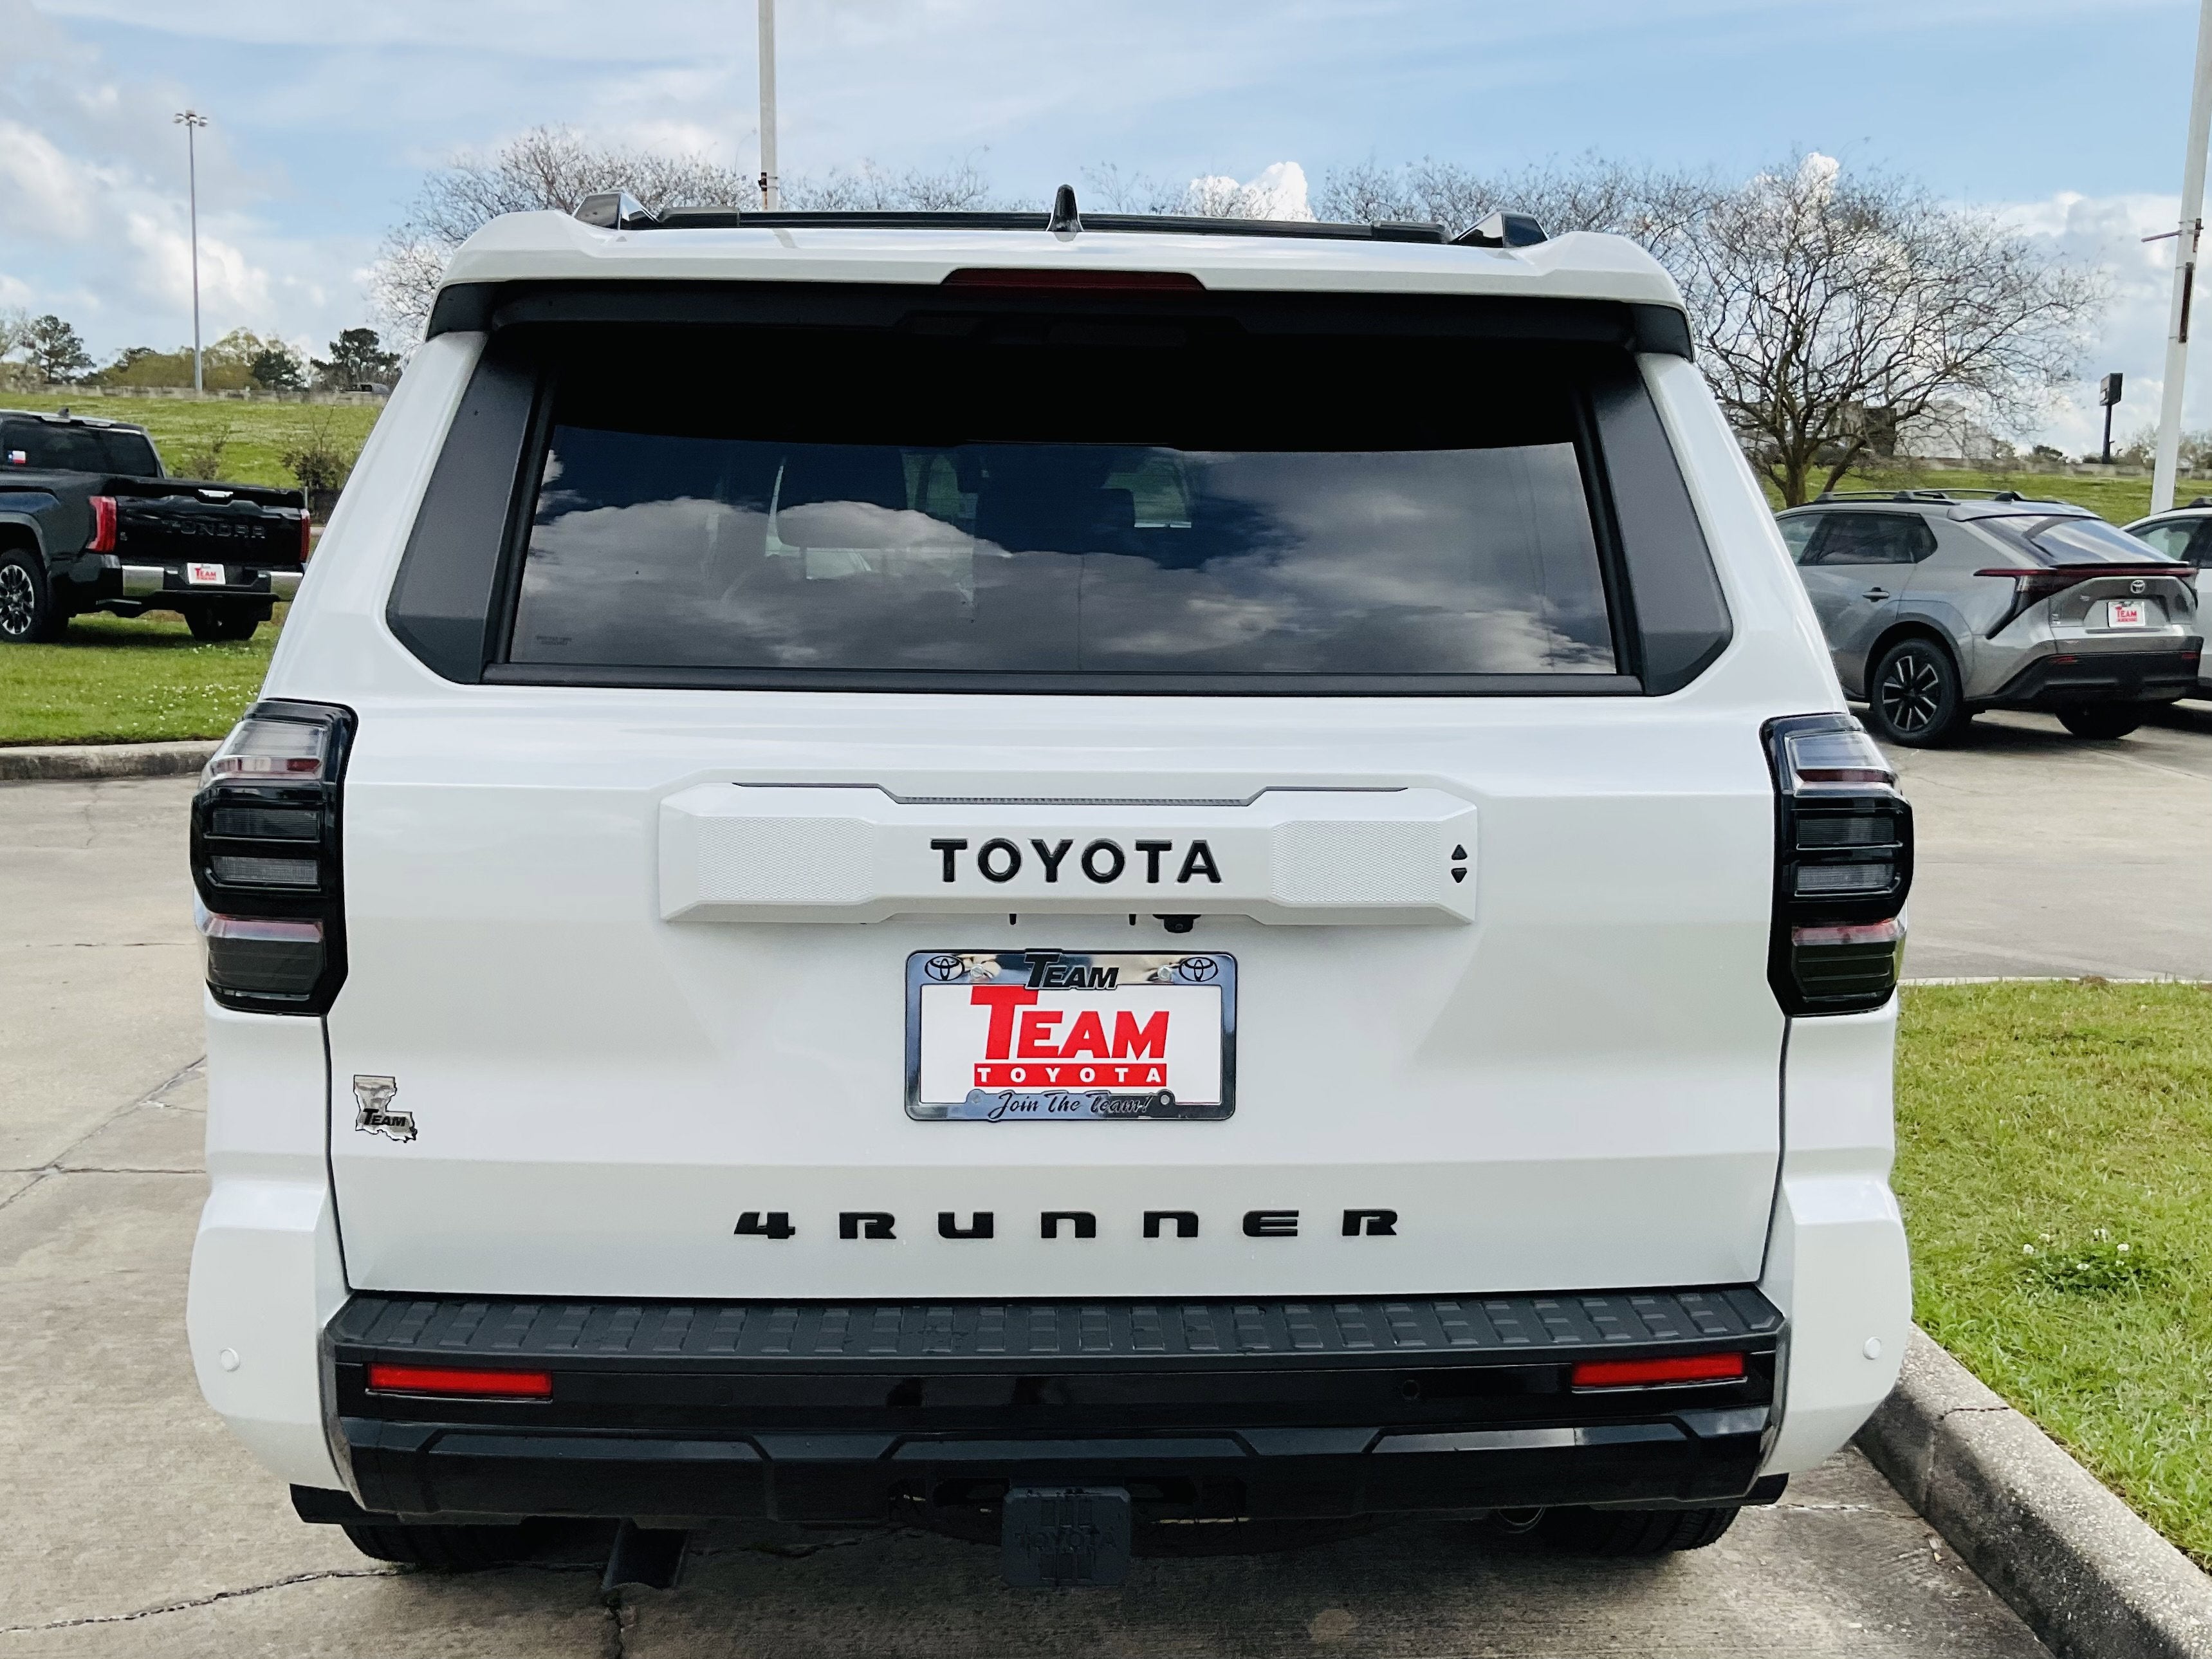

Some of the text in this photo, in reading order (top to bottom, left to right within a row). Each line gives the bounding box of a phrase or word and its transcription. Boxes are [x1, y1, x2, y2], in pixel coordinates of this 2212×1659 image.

[161, 520, 266, 539] TUNDRA
[195, 568, 216, 577] TEAM
[930, 839, 1222, 884] TOYOTA
[1026, 952, 1119, 988] TEAM
[970, 986, 1169, 1060] TEAM
[977, 1068, 1161, 1083] TOYOTA
[363, 1108, 406, 1127] TEAM
[988, 1091, 1151, 1118] Join The Team!
[734, 1209, 1398, 1239] 4RUNNER
